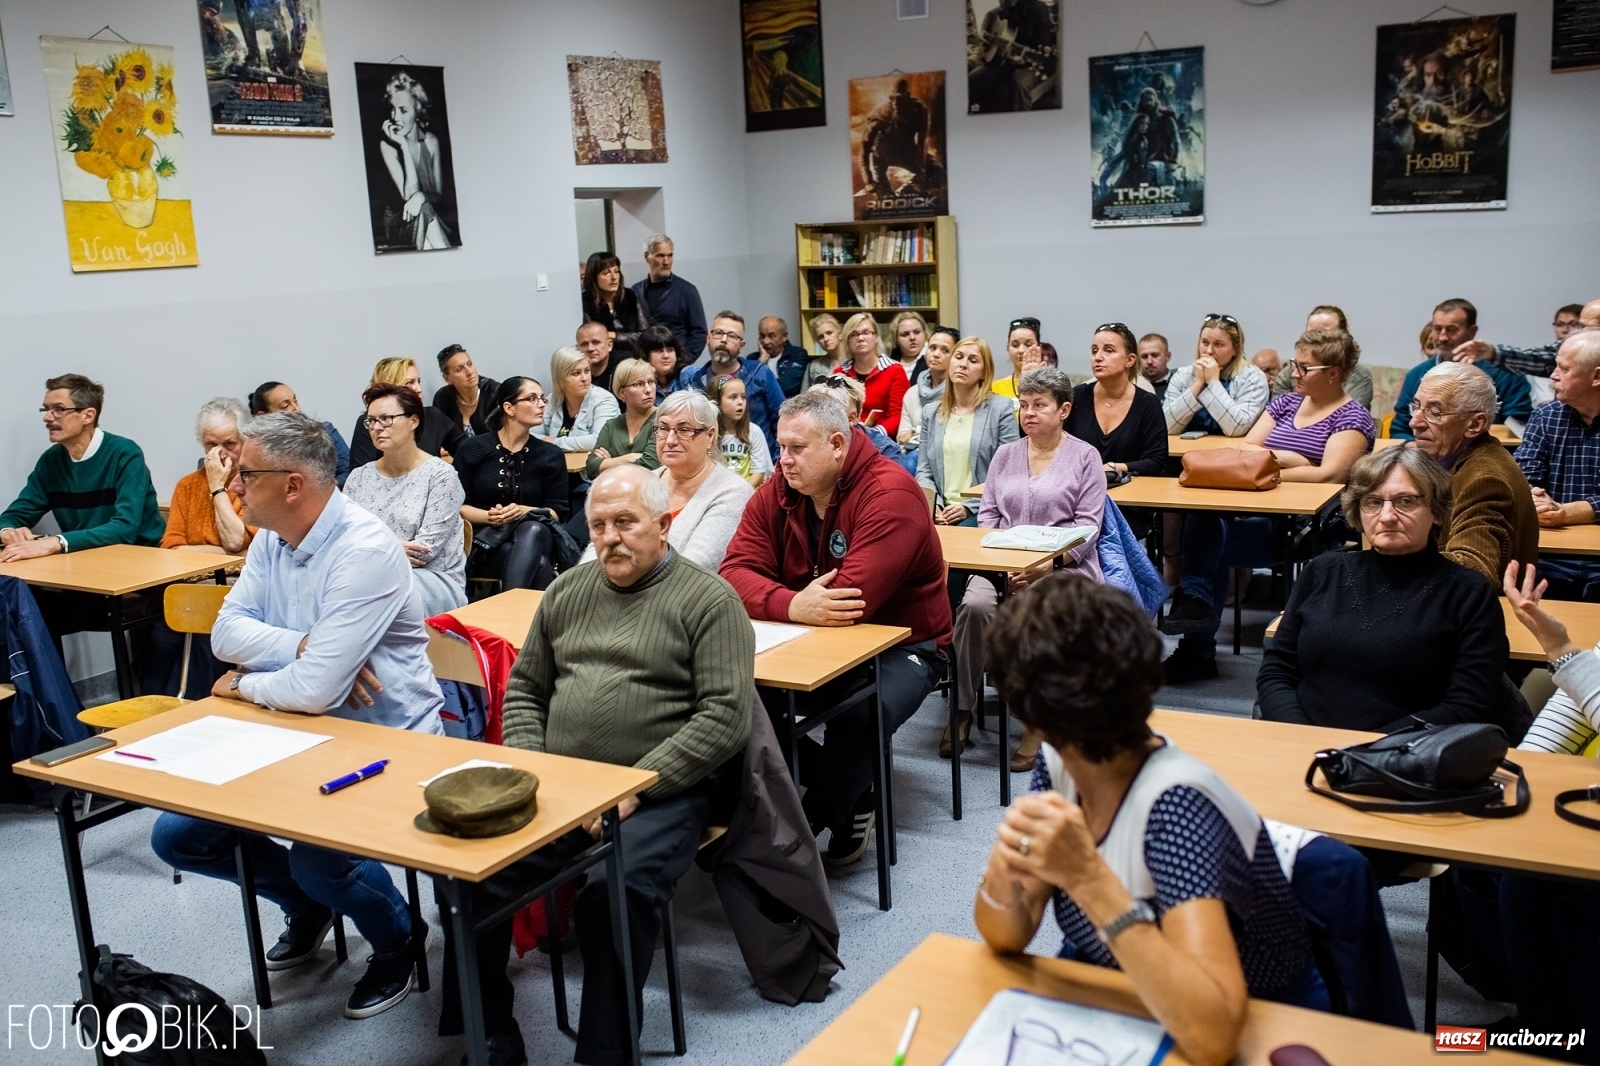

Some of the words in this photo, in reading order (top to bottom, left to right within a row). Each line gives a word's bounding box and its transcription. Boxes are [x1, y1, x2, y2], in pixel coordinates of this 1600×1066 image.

[1404, 151, 1474, 177] HOBBIT
[864, 196, 937, 210] RIDDICK
[1113, 185, 1177, 201] THOR
[79, 236, 131, 262] Van
[135, 230, 187, 264] Gogh
